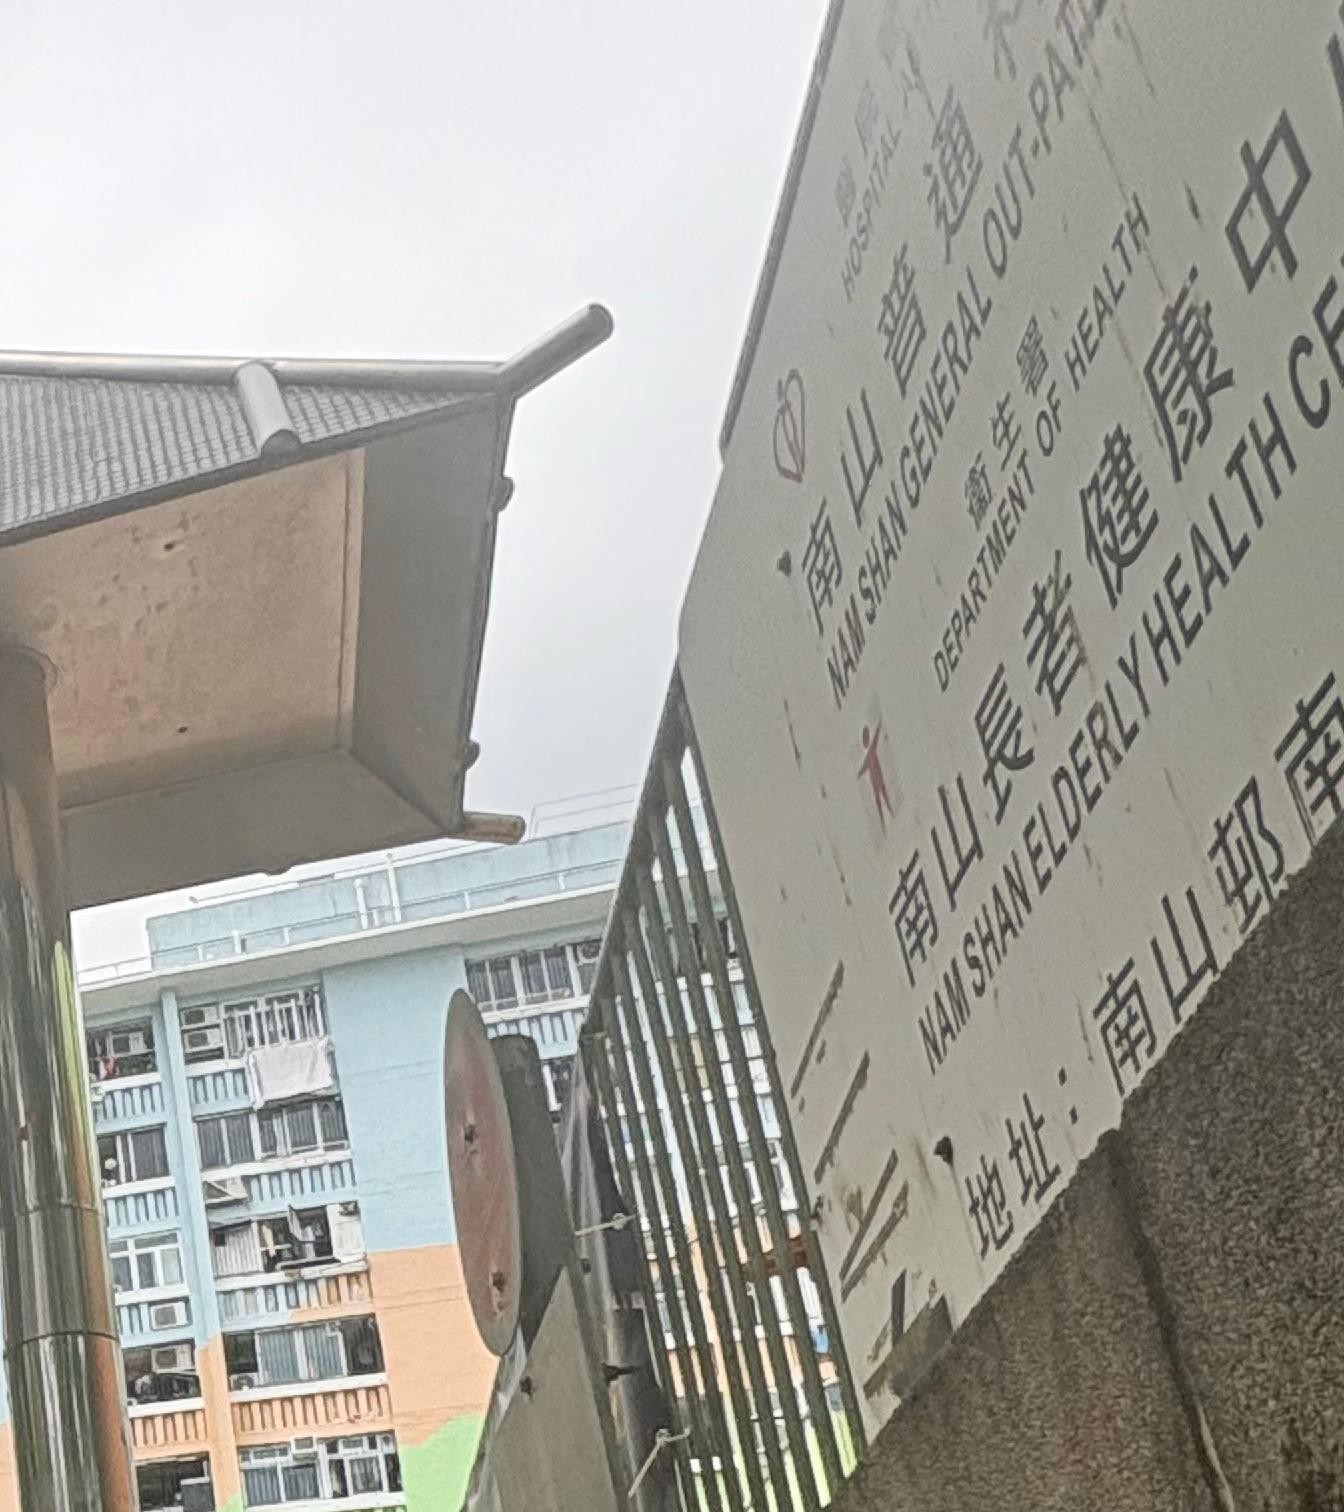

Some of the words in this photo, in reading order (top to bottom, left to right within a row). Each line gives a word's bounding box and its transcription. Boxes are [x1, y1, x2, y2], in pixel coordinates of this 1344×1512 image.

[839, 115, 903, 305] HOSPITAL
[931, 452, 1038, 693] DEPARTMENT
[1035, 381, 1065, 460] OF
[1064, 191, 1151, 394] HEALTH
[826, 606, 868, 710] NAM
[855, 494, 910, 626] SHAN
[899, 265, 993, 508] GENERAL
[889, 0, 1344, 988] 南山長者健康中
[918, 965, 970, 1076] NAM
[964, 858, 1031, 999] SHAN
[1022, 650, 1152, 895] ELDERLY
[1145, 390, 1298, 687] HEALTH
[1286, 254, 1344, 431] CE
